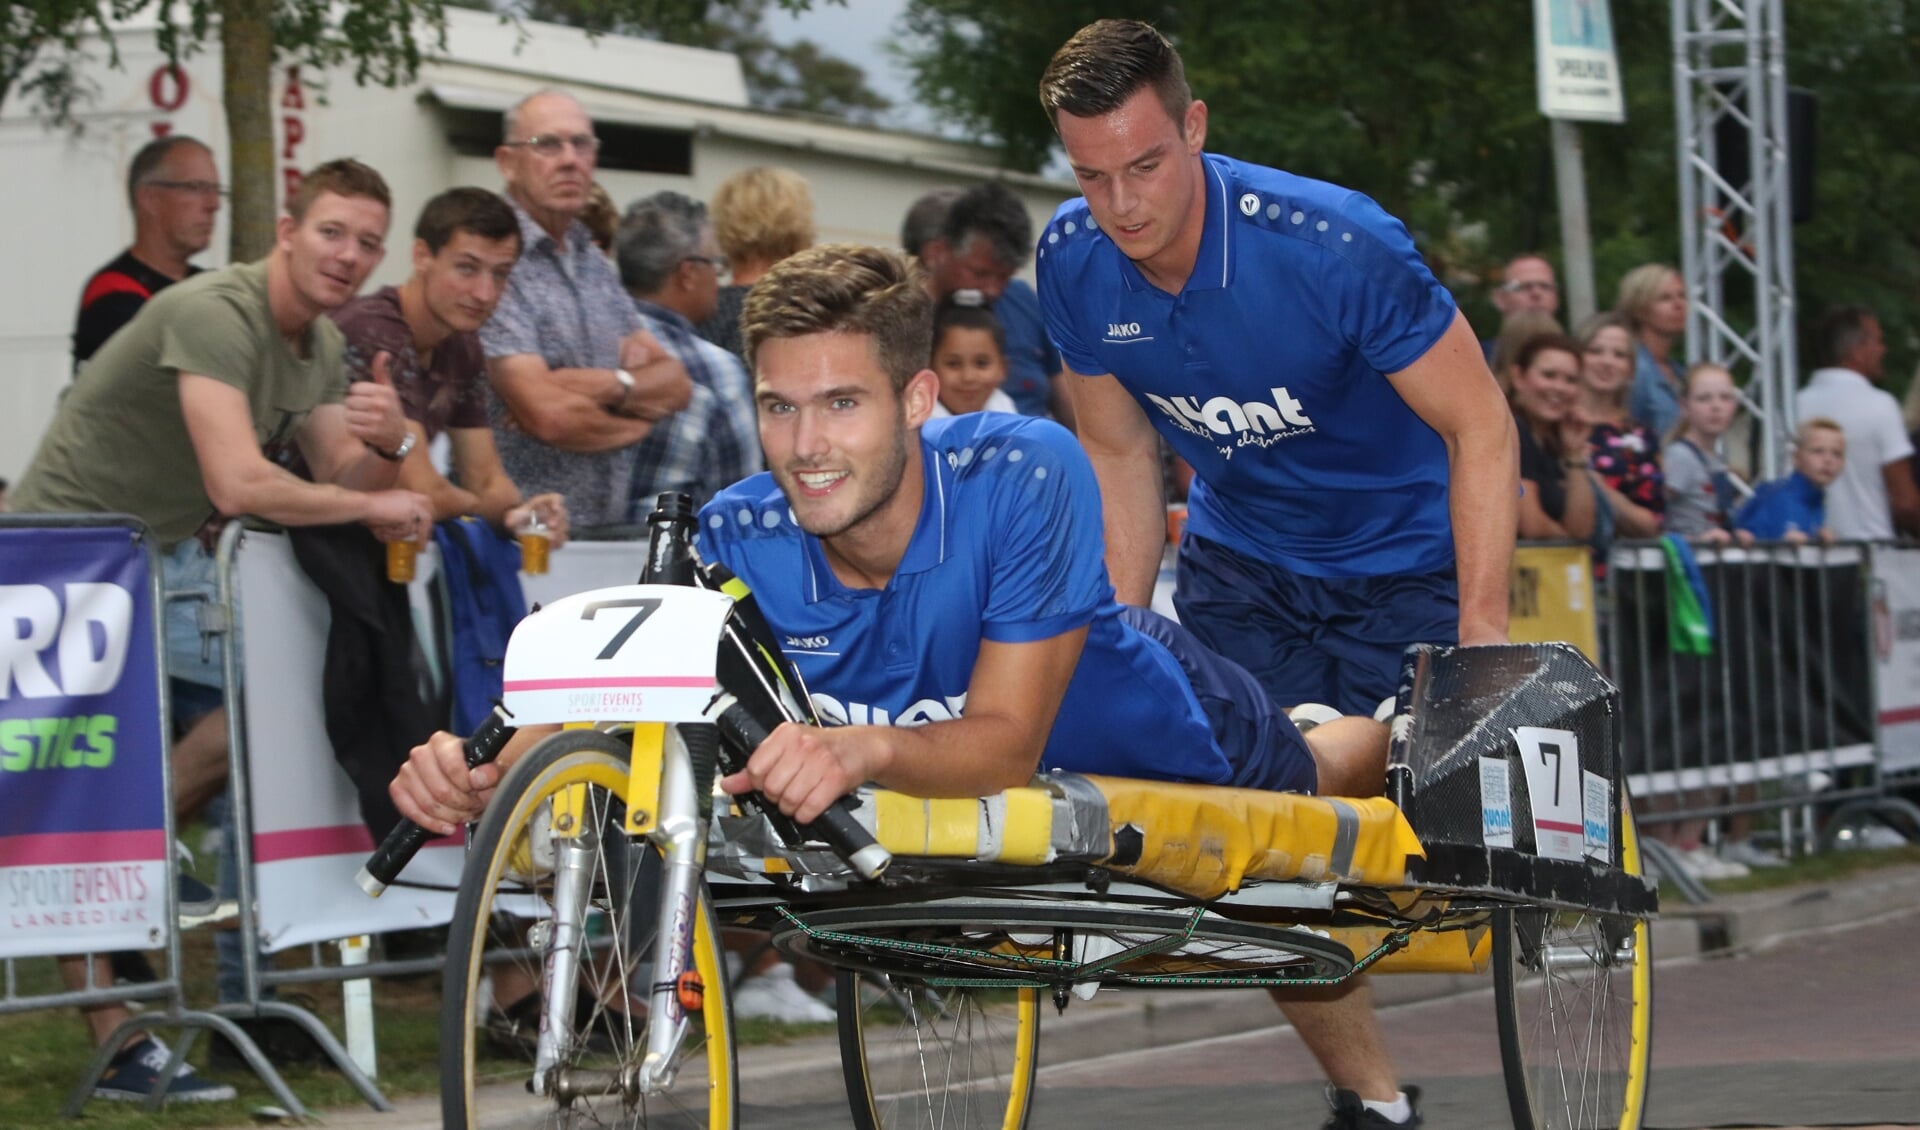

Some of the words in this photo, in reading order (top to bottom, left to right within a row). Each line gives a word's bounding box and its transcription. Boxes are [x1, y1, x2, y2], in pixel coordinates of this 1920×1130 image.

[1107, 322, 1141, 337] JAKO
[580, 598, 664, 660] 7
[785, 634, 830, 649] JAKO
[568, 693, 643, 706] SPORTEVENTS
[0, 714, 118, 772] STICS
[1538, 742, 1561, 807] 7
[1484, 804, 1511, 833] quant
[9, 865, 147, 907] SPORTEVENTS
[11, 908, 147, 928] LANGEDIJK
